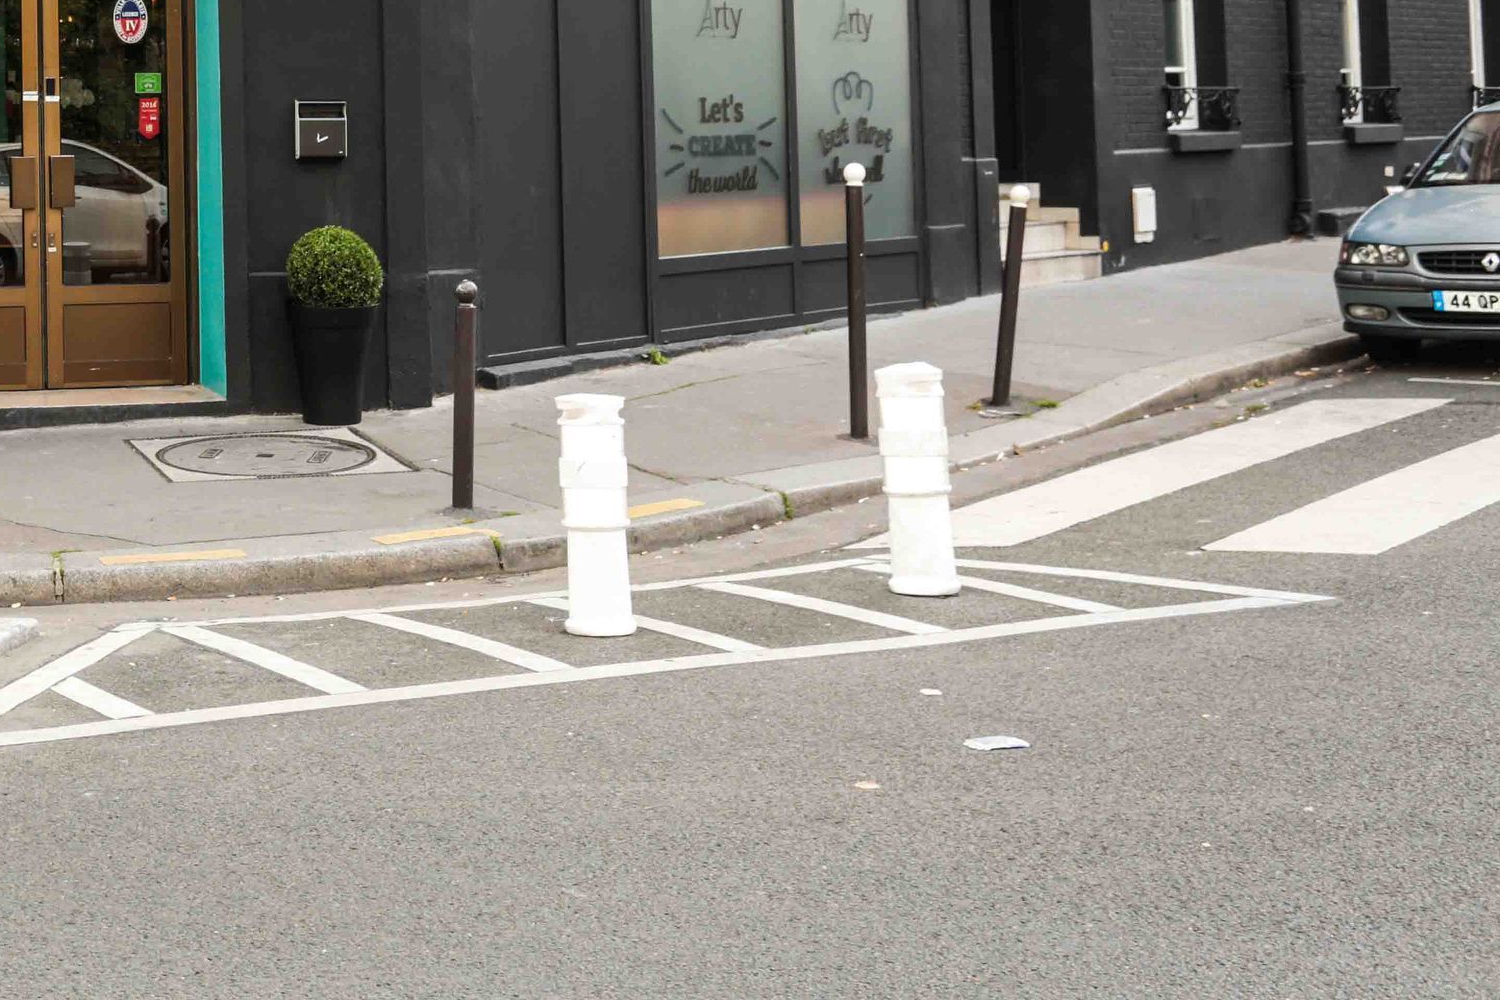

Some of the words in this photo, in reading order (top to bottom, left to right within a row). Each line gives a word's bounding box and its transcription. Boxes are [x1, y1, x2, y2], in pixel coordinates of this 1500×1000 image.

[125, 19, 139, 31] IV
[699, 94, 744, 123] Let's
[688, 134, 756, 157] CREATE
[688, 166, 714, 194] the
[713, 165, 758, 192] world
[1451, 294, 1471, 309] 44
